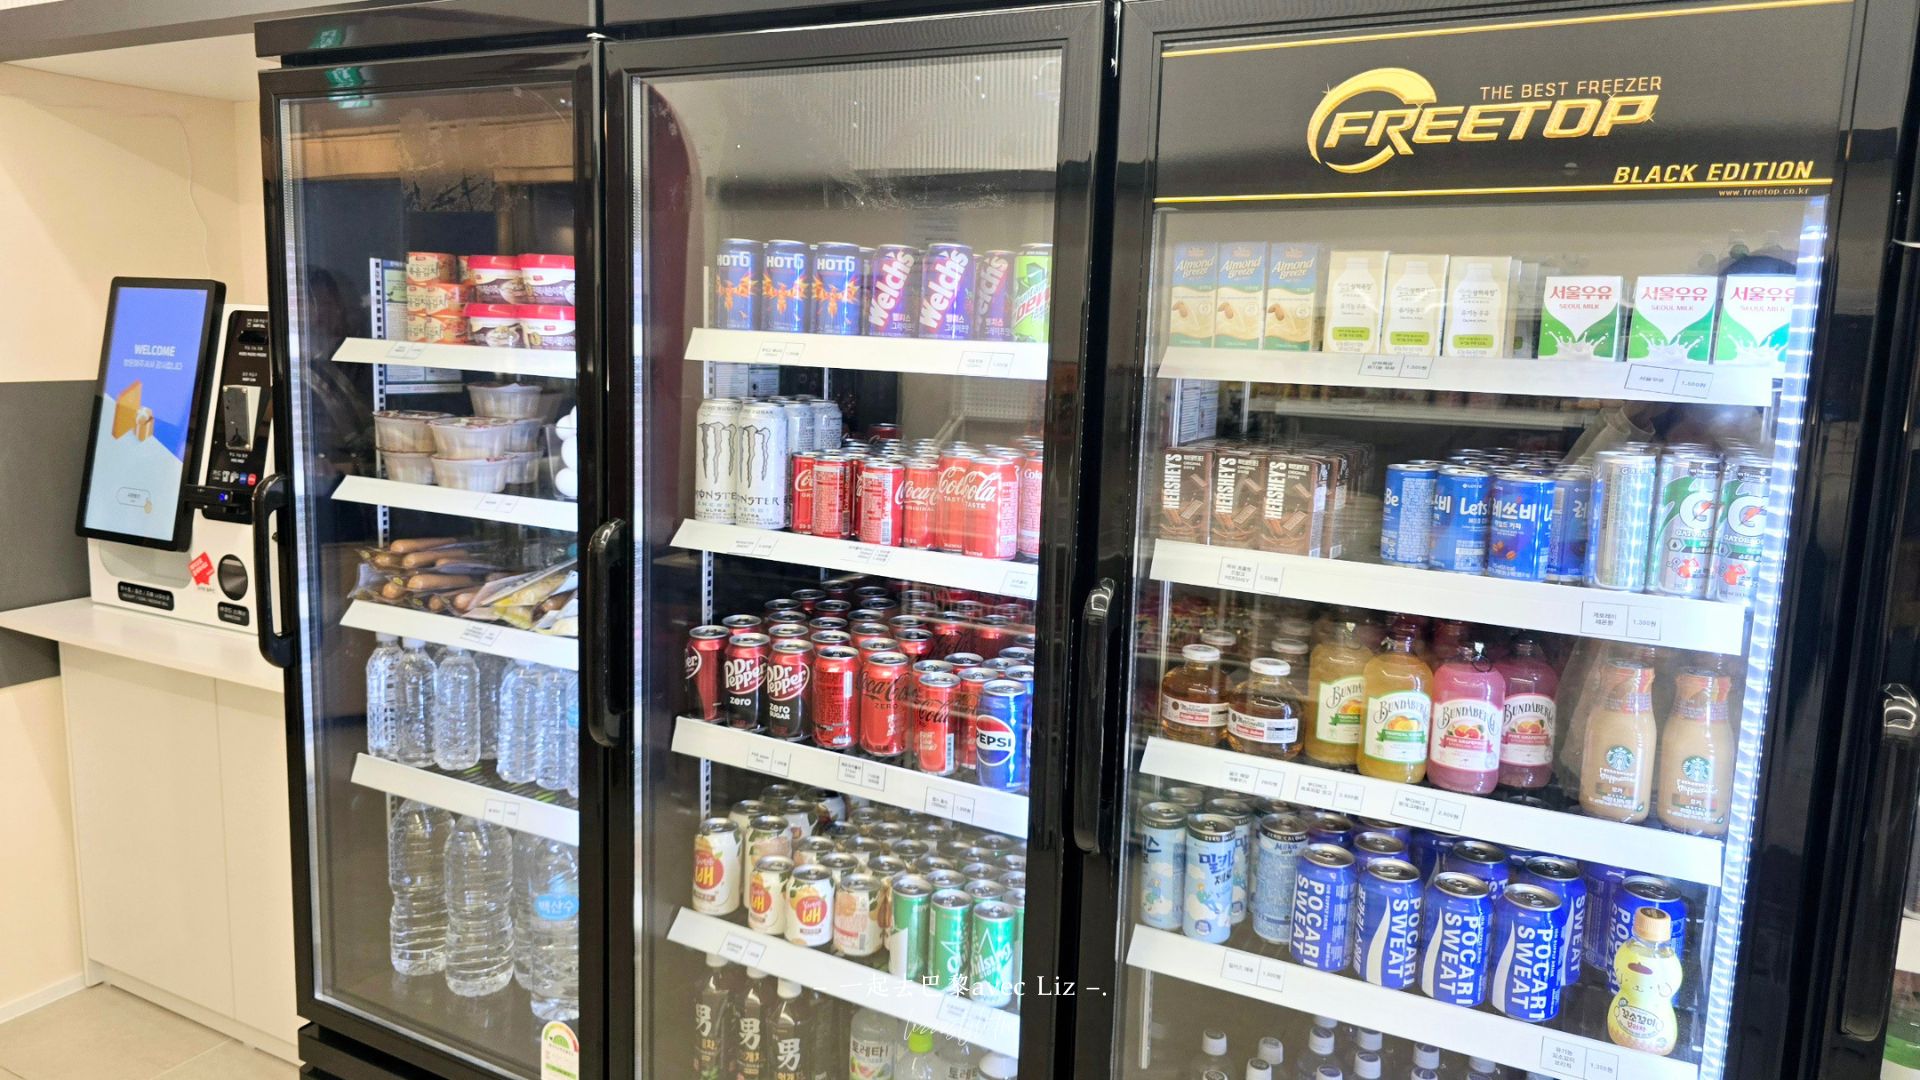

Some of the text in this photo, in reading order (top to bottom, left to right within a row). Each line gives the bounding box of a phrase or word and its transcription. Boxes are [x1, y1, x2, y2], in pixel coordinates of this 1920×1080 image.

[1480, 76, 1662, 101] THE BEST FREEZER
[1322, 94, 1660, 156] FREETOP
[1613, 160, 1815, 184] BLACK EDITION
[1718, 187, 1810, 198] www.freetop.co.kr
[1174, 255, 1217, 273] Almond
[1220, 255, 1263, 273] Almond
[1271, 256, 1315, 273] Almond
[1550, 285, 1613, 300] 서울우유
[1641, 286, 1708, 301] 서울우유
[134, 344, 176, 357] WELCOME
[1163, 454, 1183, 510] HERSHEY'S
[1215, 457, 1237, 514] HERSHEY'S
[1264, 461, 1287, 519] HERSHEY'S
[724, 660, 768, 691] Pepper
[734, 658, 755, 673] Dr
[766, 665, 806, 697] Pepper
[776, 664, 793, 679] Dr
[730, 697, 752, 706] zero
[769, 703, 791, 714] zero
[769, 711, 791, 720] SUGAR
[1198, 850, 1235, 874] 밀키
[1293, 874, 1310, 955] SWEAT
[1303, 880, 1326, 968] POCARI
[1387, 899, 1410, 978] SWEAT
[1403, 897, 1422, 988] POCARI
[1570, 895, 1586, 972] SWEAT
[1439, 913, 1463, 996] SWEAT
[1456, 915, 1480, 1006] POCARI
[1511, 925, 1536, 1010] SWEAT
[1529, 928, 1553, 1020] POCARI
[695, 1003, 712, 1037] 男
[1621, 1007, 1657, 1026] 꼬소꼬미
[738, 1017, 761, 1051] 男
[776, 1037, 801, 1072] 男
